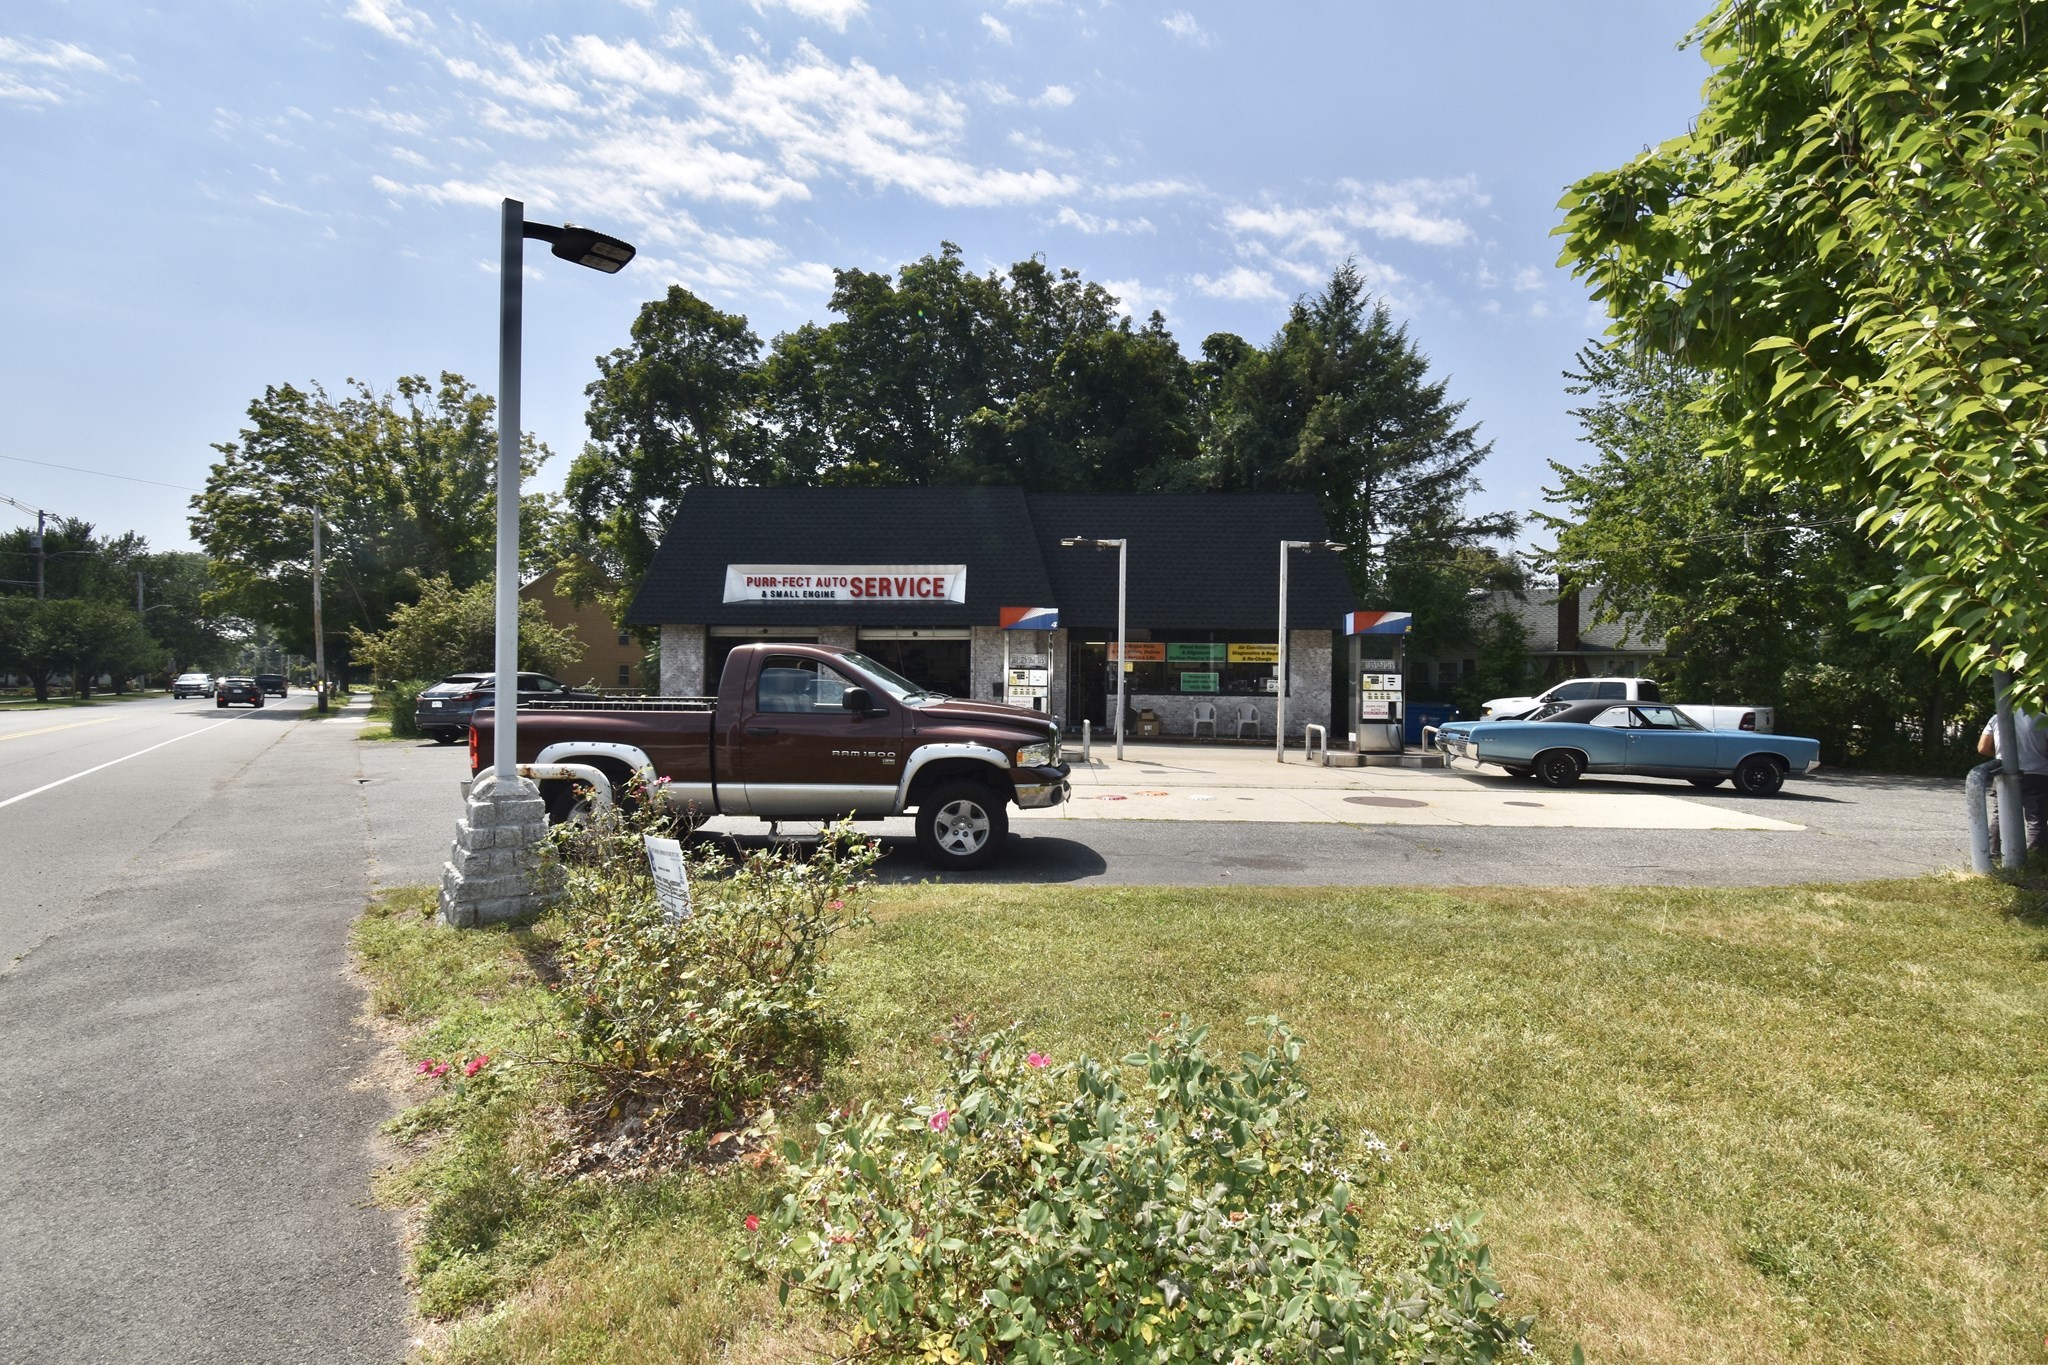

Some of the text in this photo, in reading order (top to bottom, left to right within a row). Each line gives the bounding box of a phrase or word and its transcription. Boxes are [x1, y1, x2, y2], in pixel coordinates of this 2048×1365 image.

[746, 576, 945, 598] PURR-FECT AUTO SERVICE
[761, 590, 836, 598] & SMALL ENGINE
